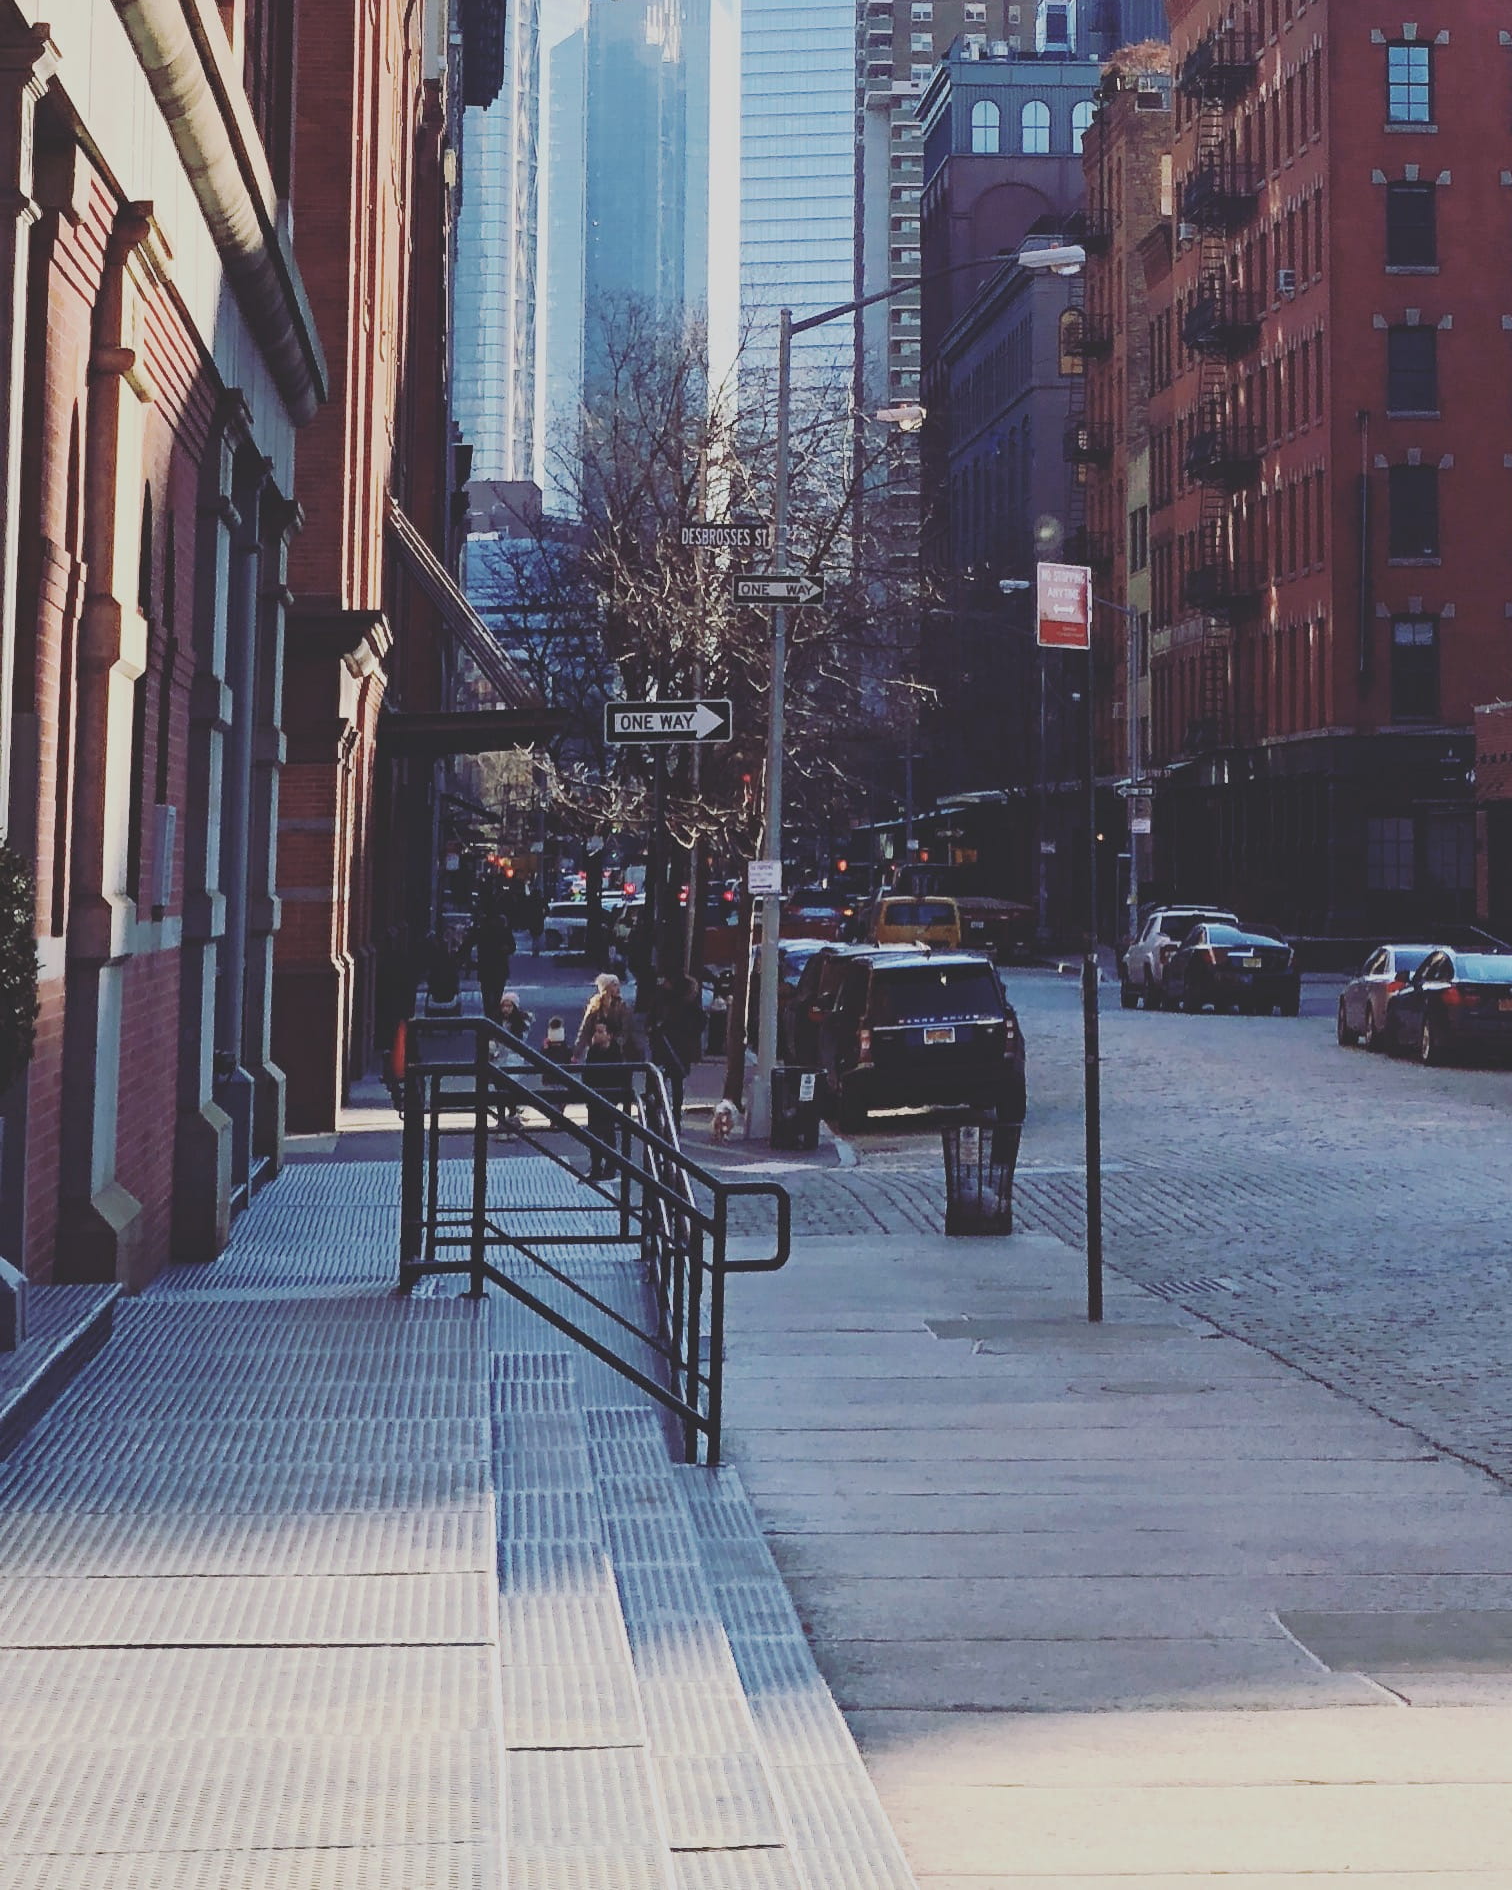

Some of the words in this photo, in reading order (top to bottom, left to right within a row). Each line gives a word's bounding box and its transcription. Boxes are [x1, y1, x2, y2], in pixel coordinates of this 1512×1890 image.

[681, 527, 750, 546] DESBROSSES
[755, 528, 767, 546] ST
[741, 584, 770, 595] ONE
[785, 584, 814, 596] WAY
[620, 714, 654, 730] ONE
[660, 713, 695, 730] WAY
